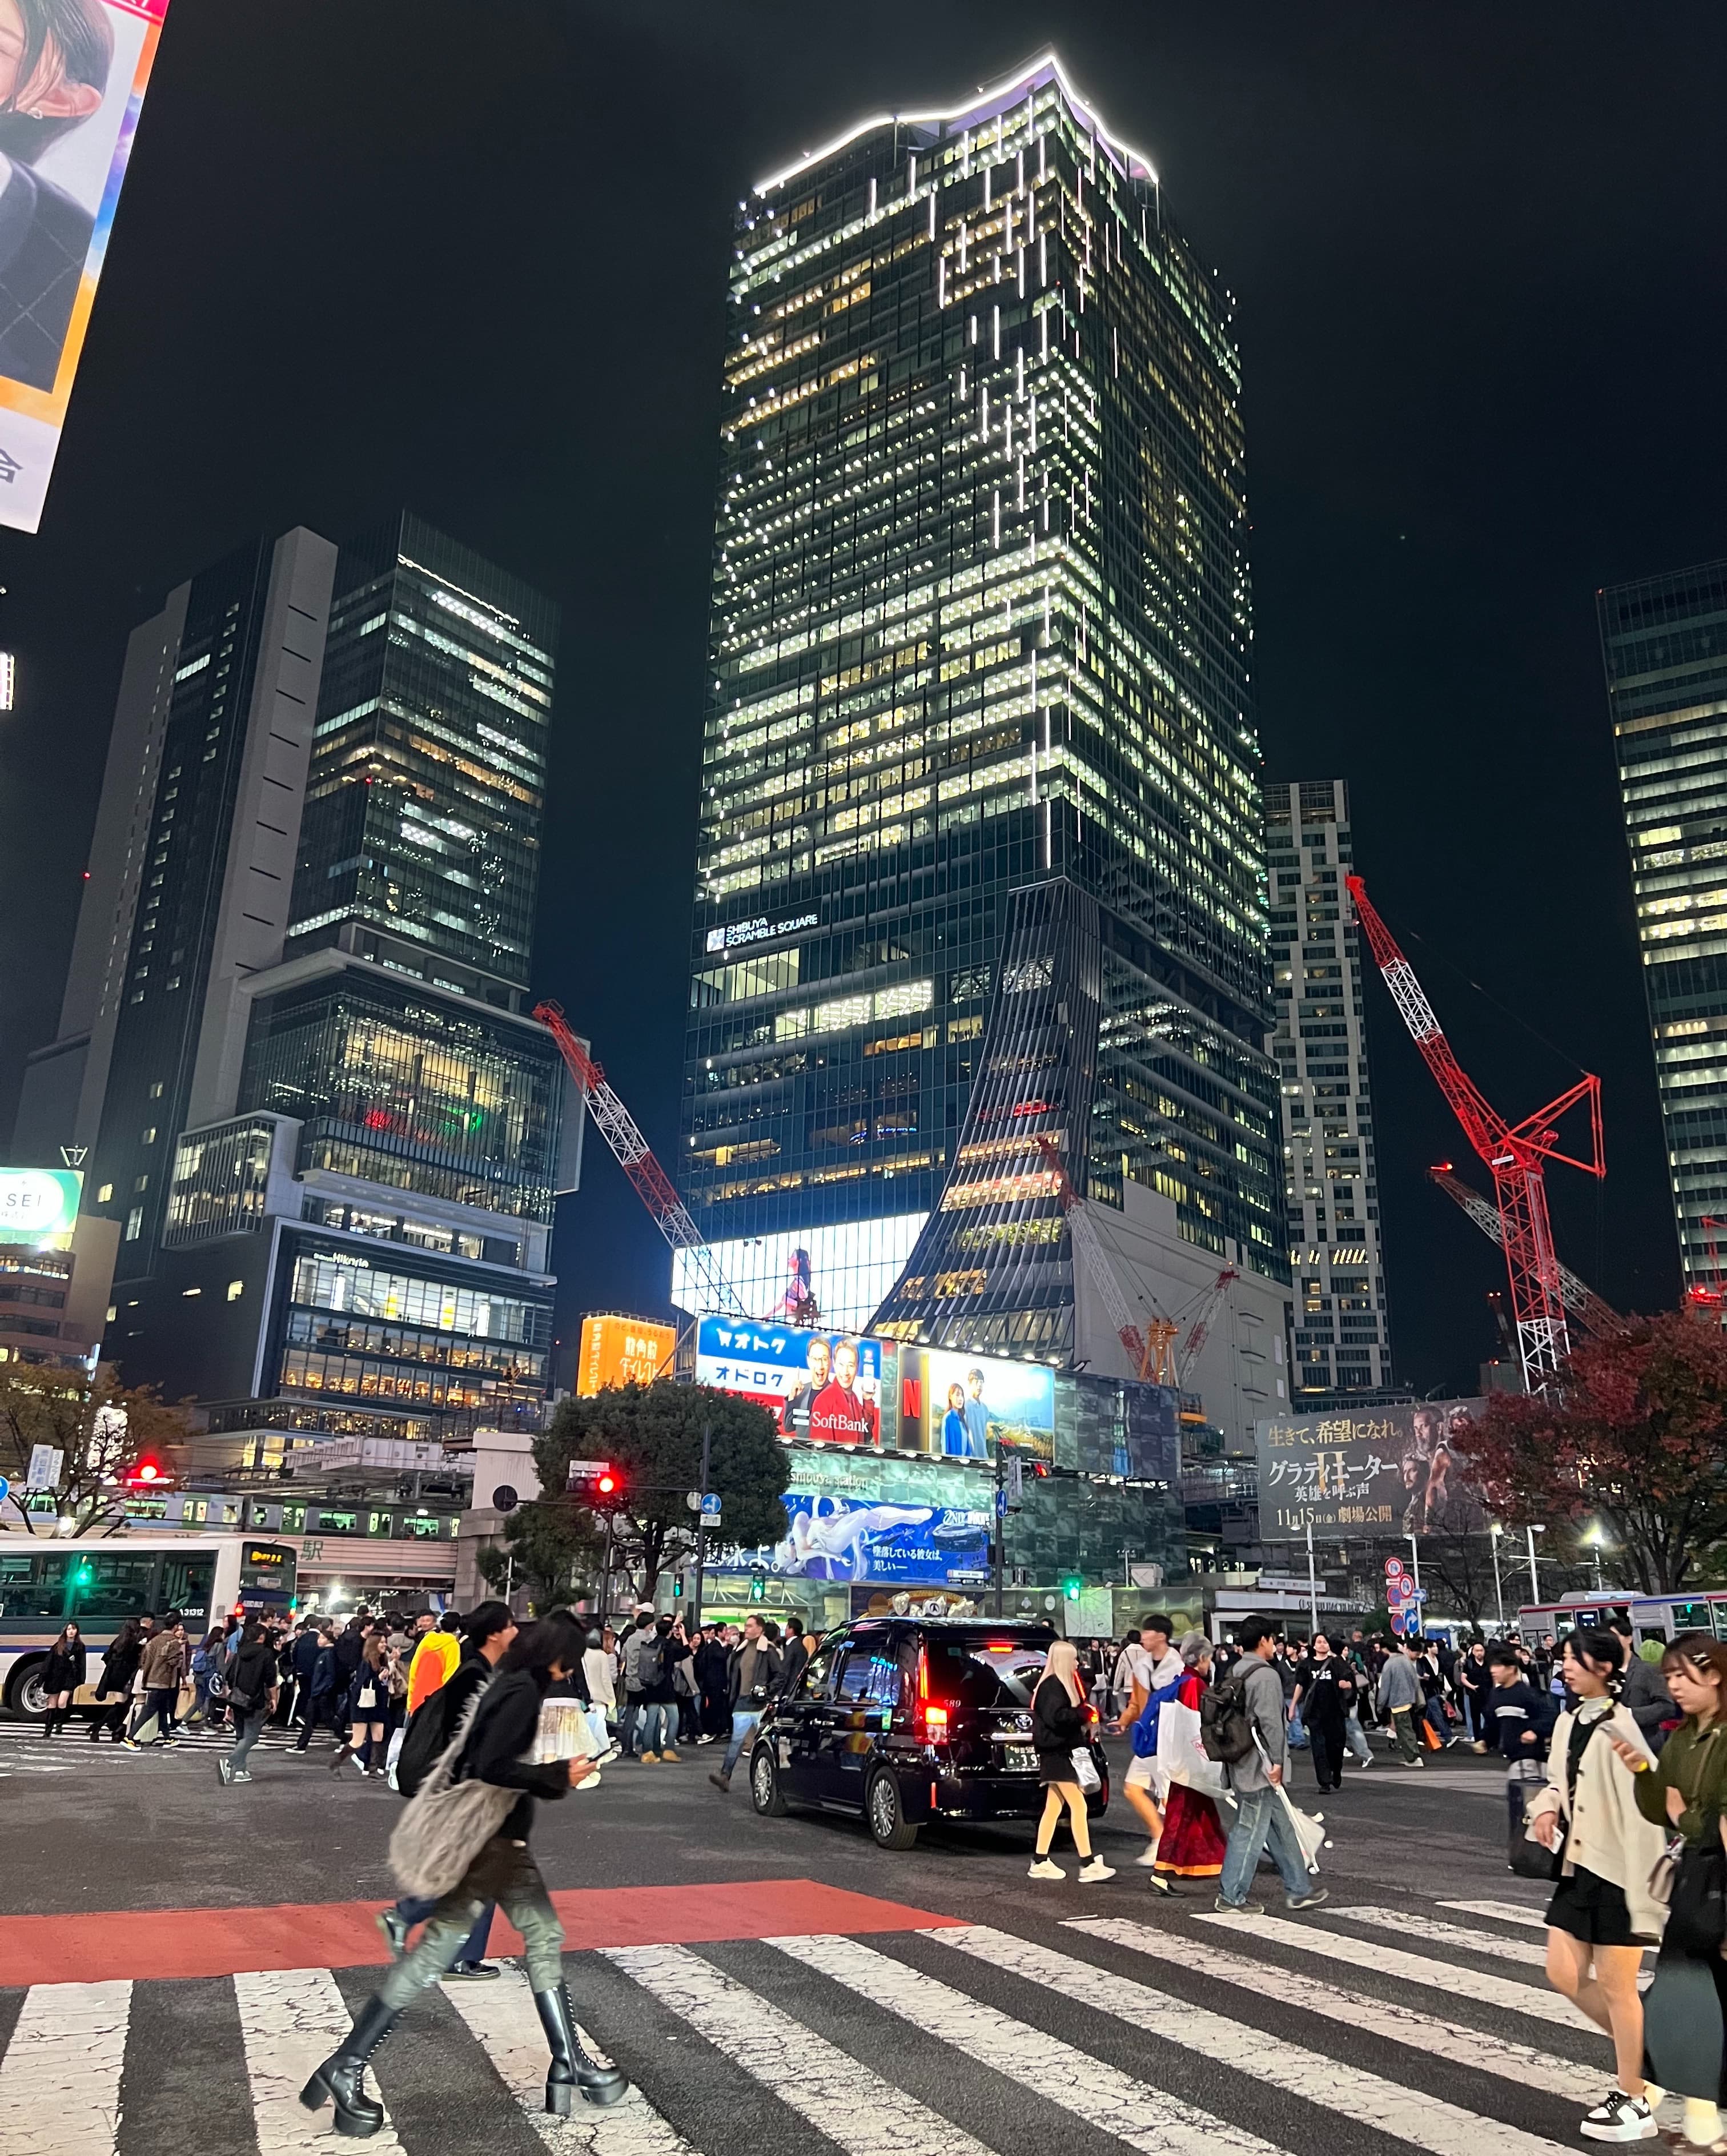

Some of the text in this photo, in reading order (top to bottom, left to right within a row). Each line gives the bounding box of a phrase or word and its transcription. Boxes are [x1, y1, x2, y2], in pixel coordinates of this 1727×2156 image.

[726, 917, 768, 937] SHIBUYA
[726, 914, 818, 947] SCRAMBLE SQUARE
[734, 1334, 786, 1354] オトク
[716, 1366, 784, 1387] オドロク
[903, 1378, 921, 1418] N
[812, 1411, 869, 1433] SoftBank
[1268, 1419, 1403, 1447] 生きて、希望になれ。
[1268, 1454, 1398, 1486] グラディエーター
[1295, 1482, 1370, 1502] 英雄を呼ぶ声
[300, 1540, 324, 1560] 駅
